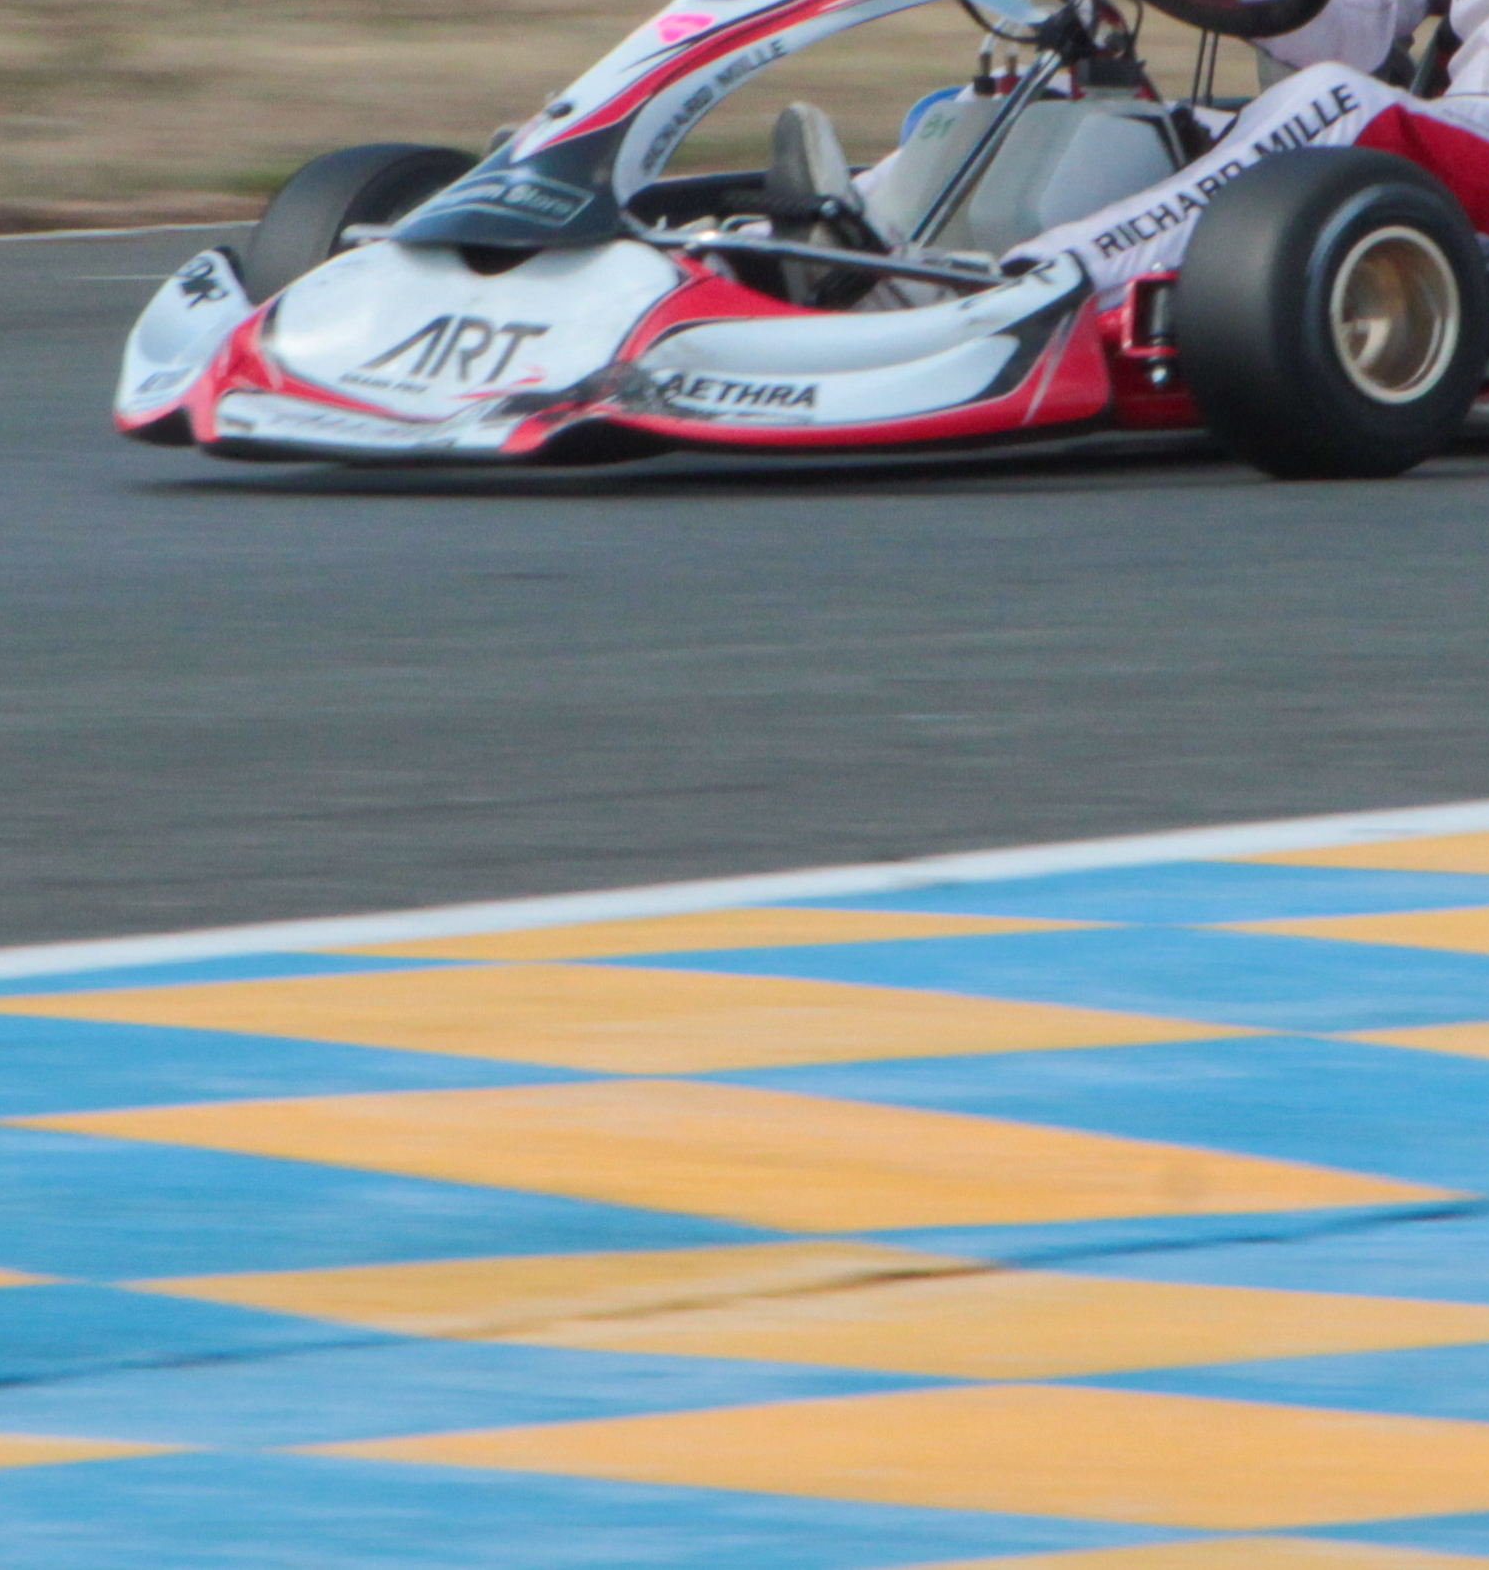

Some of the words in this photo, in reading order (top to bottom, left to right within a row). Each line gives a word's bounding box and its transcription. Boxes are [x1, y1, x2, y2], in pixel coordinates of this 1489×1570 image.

[1253, 83, 1360, 157] MILLE
[363, 314, 553, 384] ART
[660, 372, 817, 409] AETHRA
